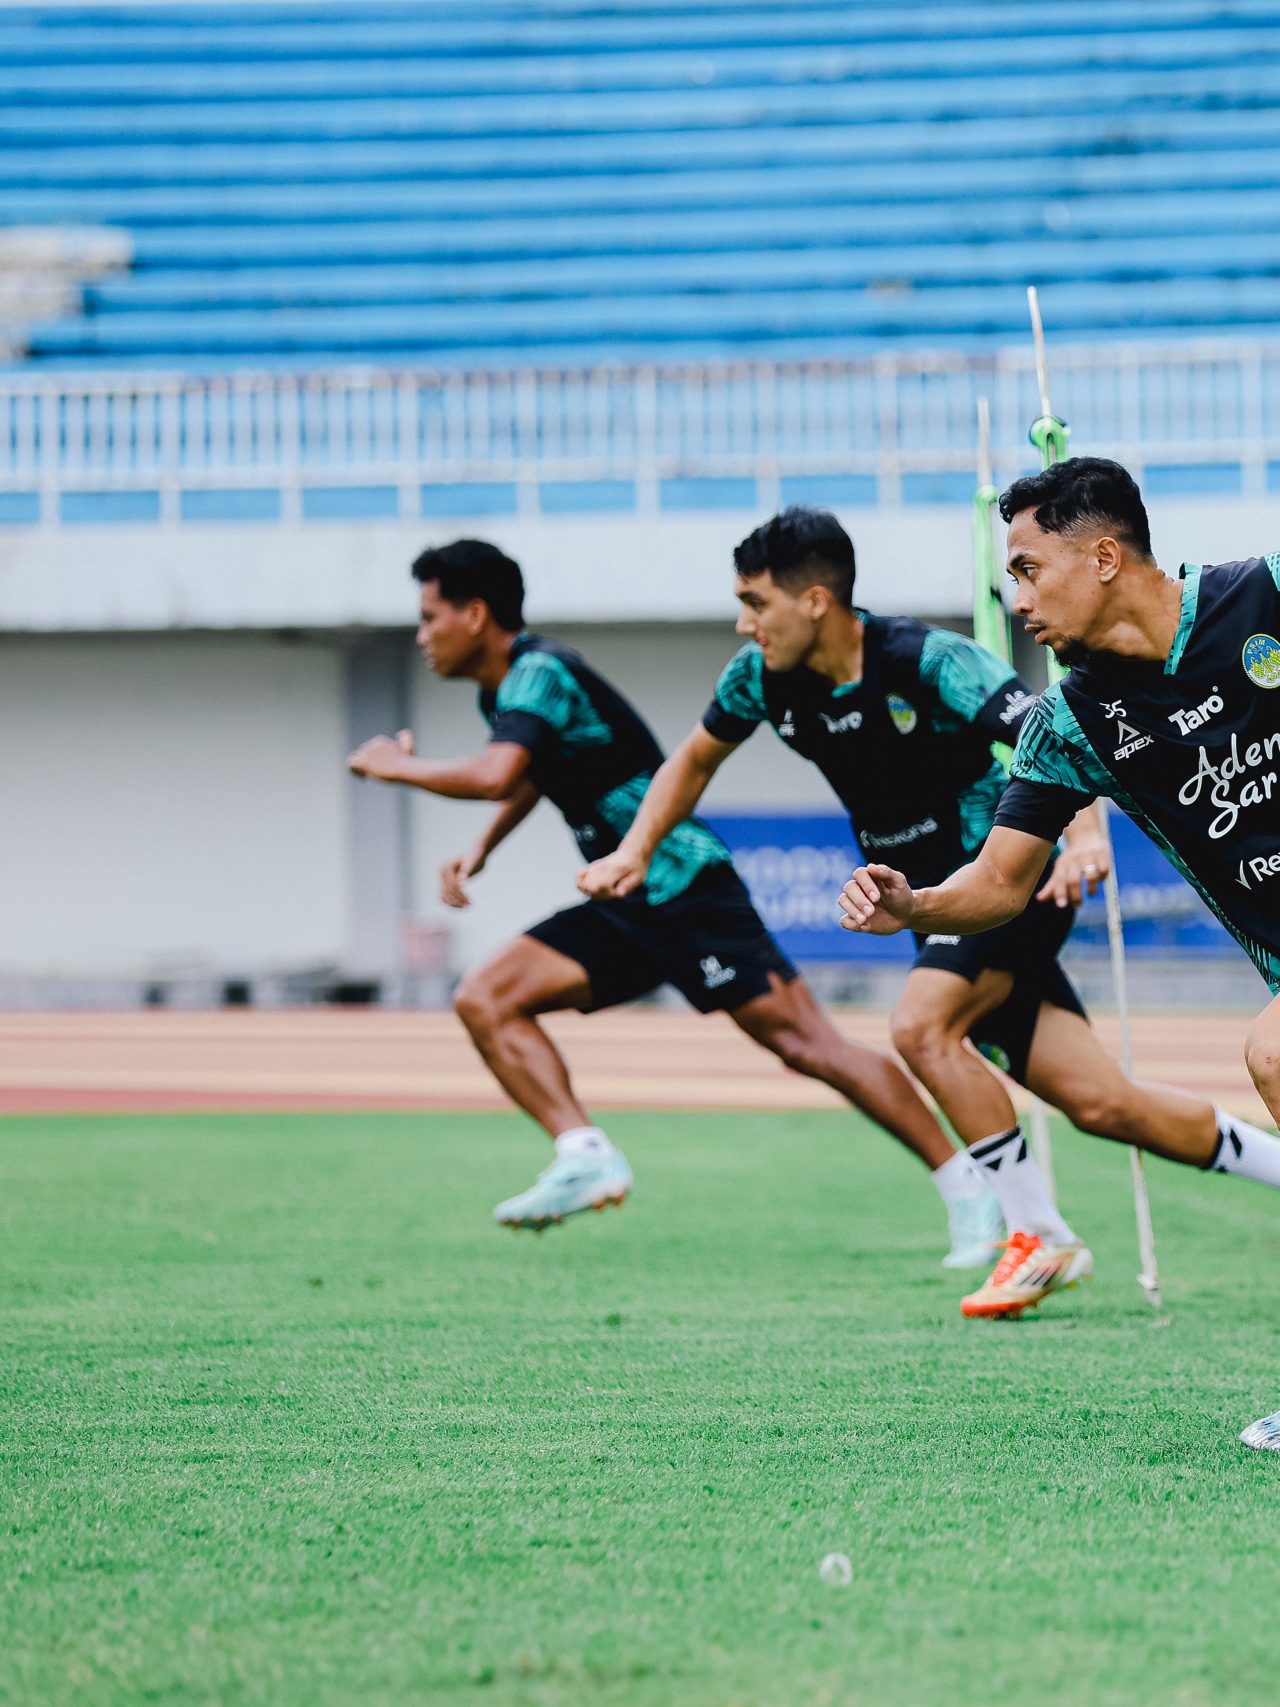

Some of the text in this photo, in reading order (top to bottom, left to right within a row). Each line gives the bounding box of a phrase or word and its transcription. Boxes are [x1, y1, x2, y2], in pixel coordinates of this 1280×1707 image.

[1099, 699, 1127, 719] 35
[1167, 694, 1225, 737] Taro
[1113, 734, 1155, 761] apex
